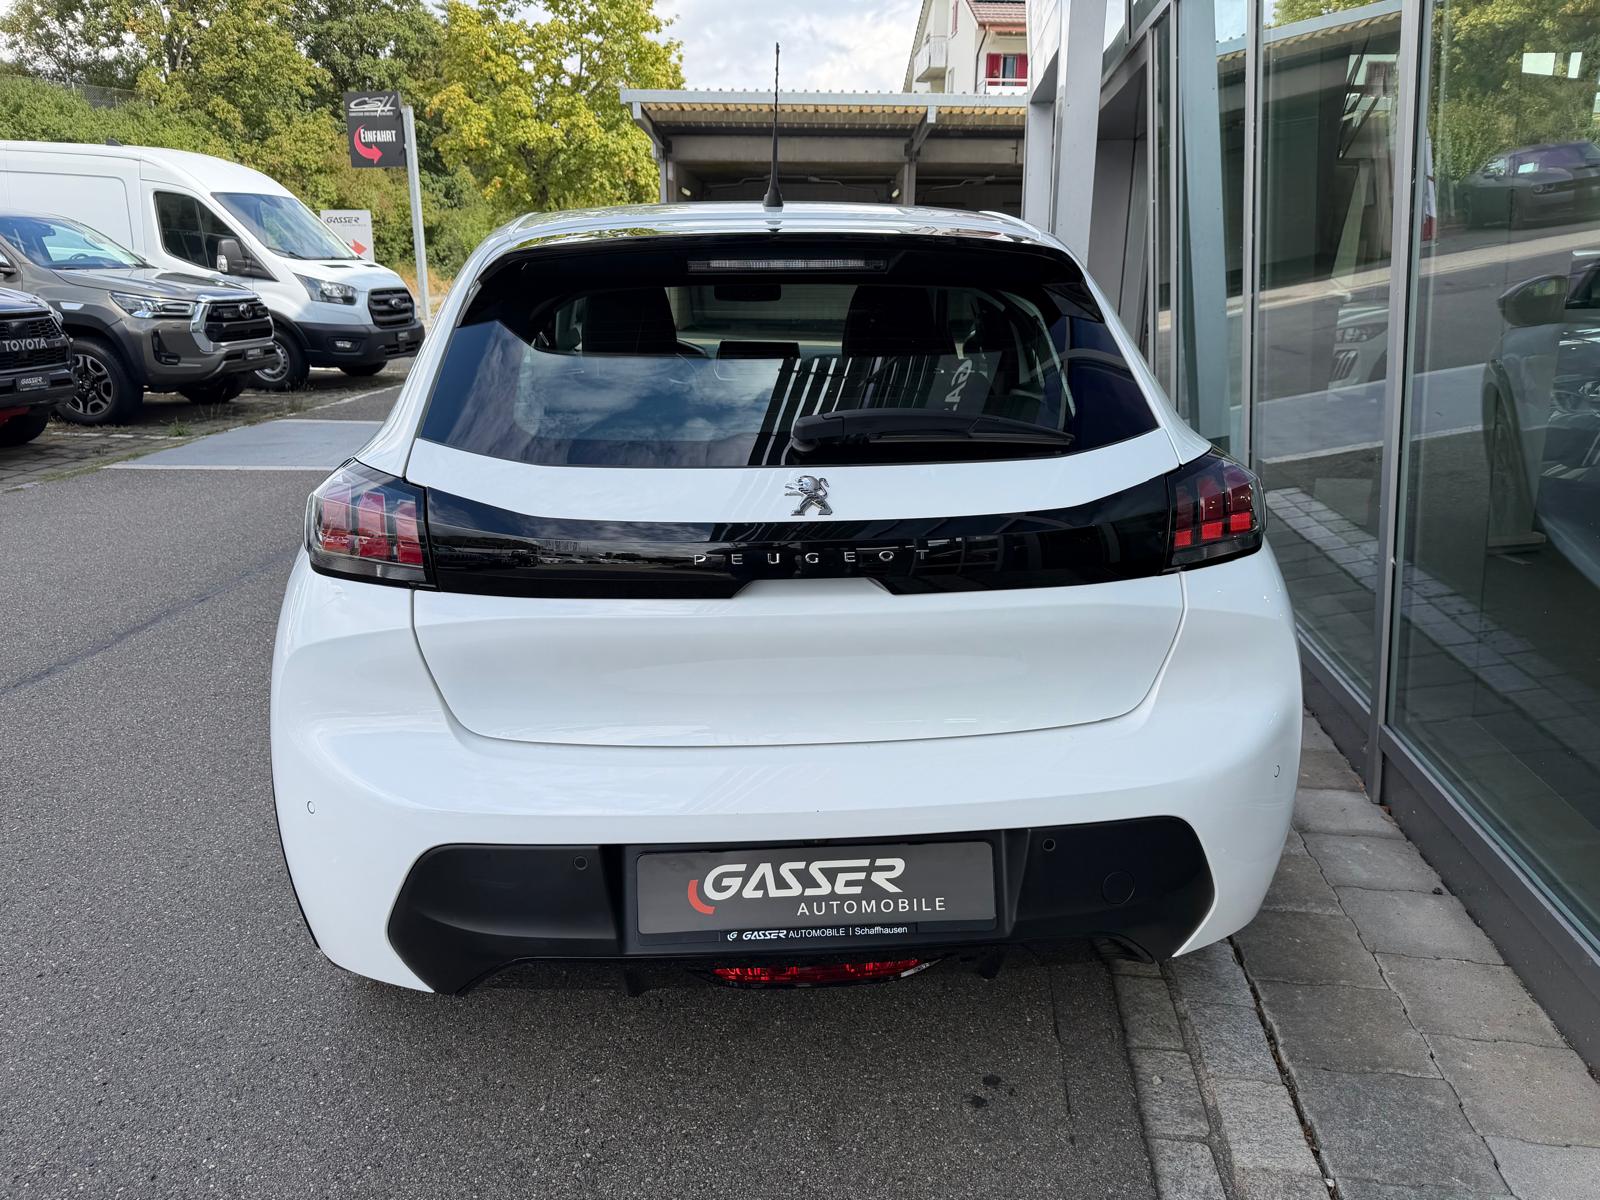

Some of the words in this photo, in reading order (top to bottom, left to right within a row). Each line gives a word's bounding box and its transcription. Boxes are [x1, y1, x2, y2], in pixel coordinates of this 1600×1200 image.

[360, 129, 396, 143] EINFAHRT
[326, 216, 360, 224] GASSER
[2, 338, 48, 352] TOYOTA
[693, 550, 927, 566] PEUGEOT
[703, 857, 906, 900] GASSER
[796, 897, 946, 916] AUTOMOBILE
[742, 930, 786, 940] GASSER
[788, 927, 845, 938] AUTOMOBILE
[854, 926, 908, 935] Schaffhausen
